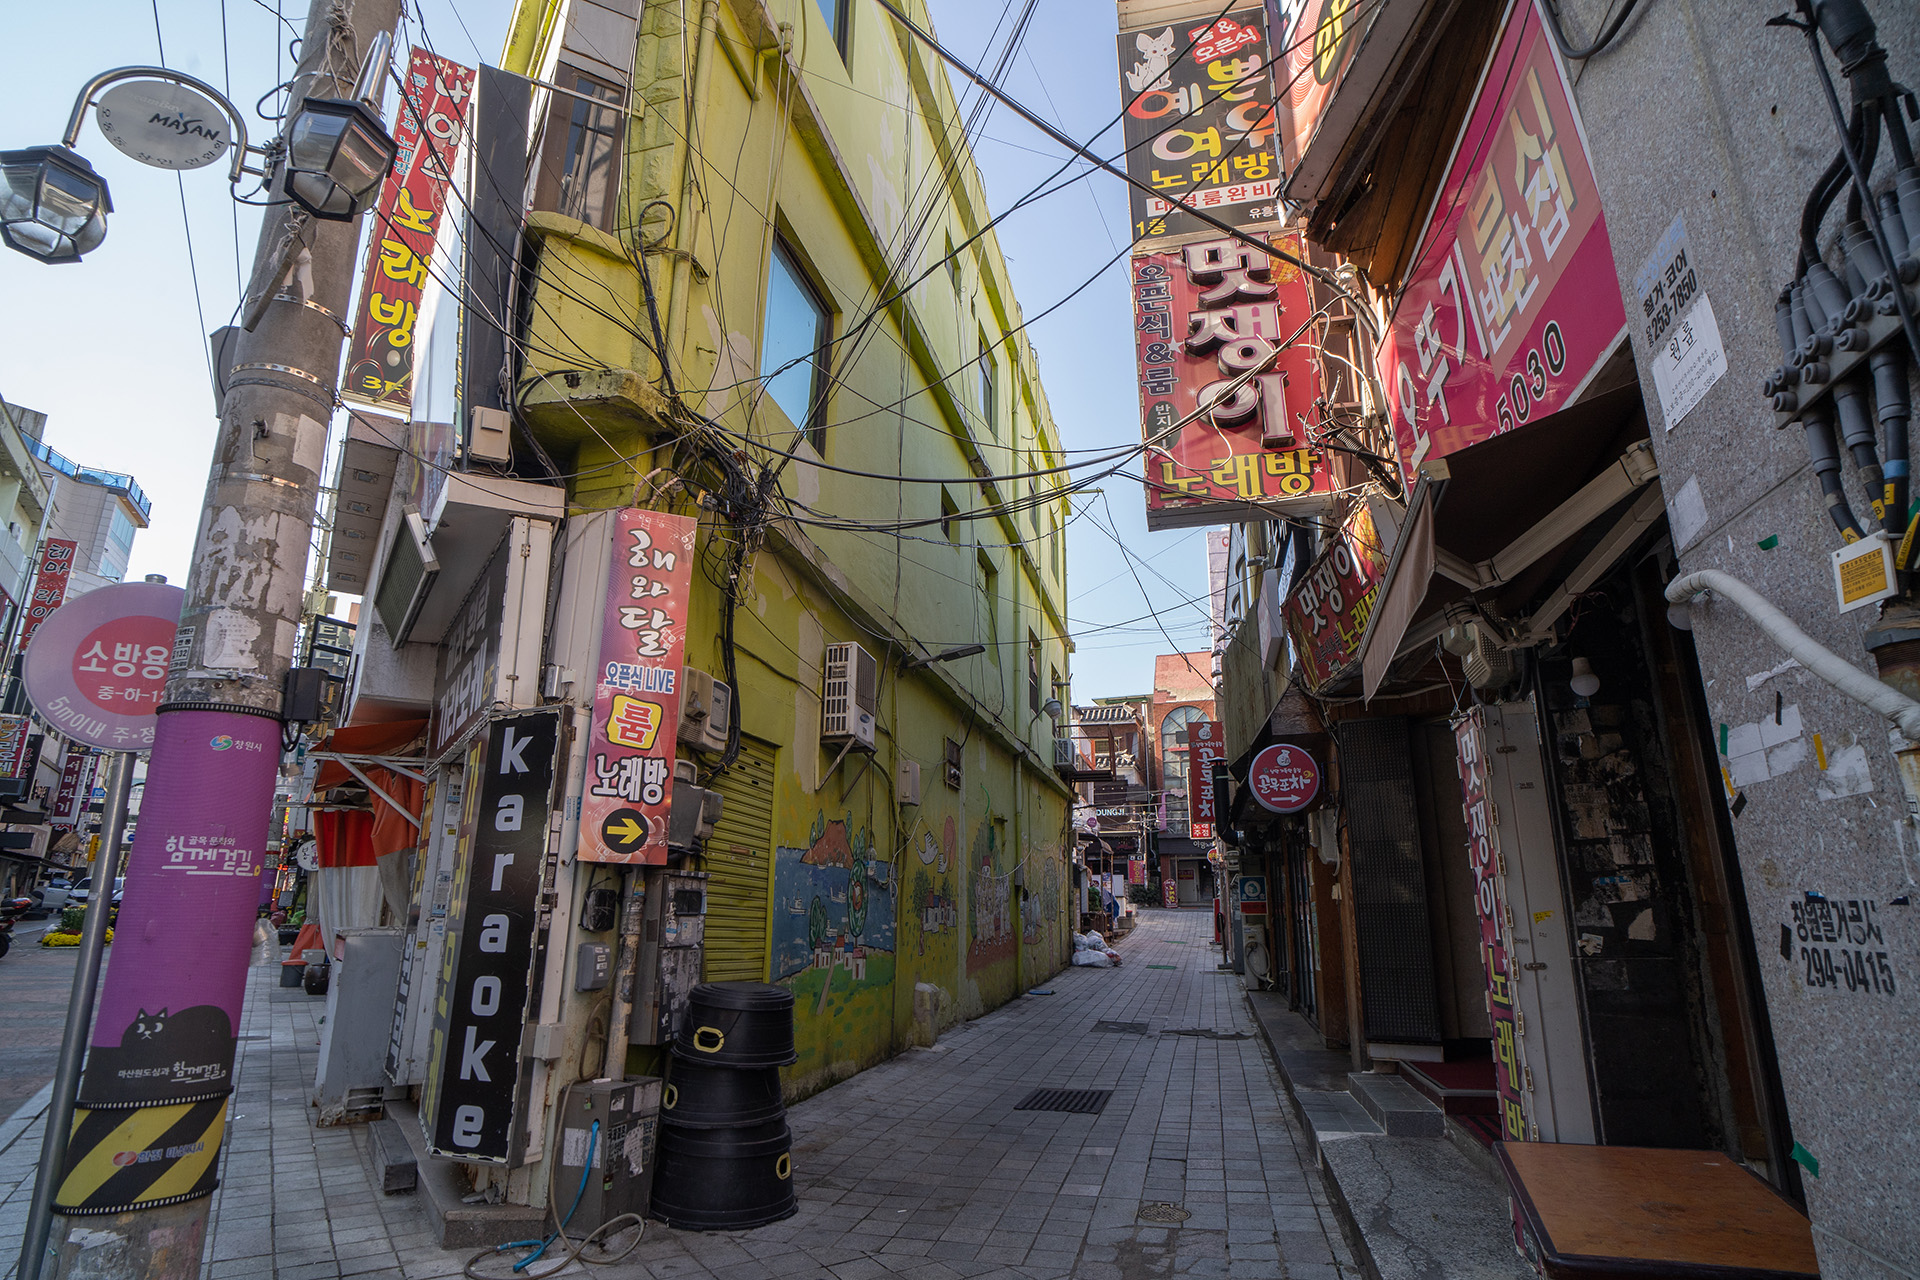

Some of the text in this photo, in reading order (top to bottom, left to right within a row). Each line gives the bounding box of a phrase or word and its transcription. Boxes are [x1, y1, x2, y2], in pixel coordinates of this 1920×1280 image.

[1194, 27, 1259, 63] 오픈식
[1217, 19, 1237, 34] &
[148, 112, 220, 141] MASAN
[1151, 151, 1275, 190] 노래방
[1136, 217, 1167, 237] 1층
[369, 186, 436, 348] 노래방
[1477, 149, 1571, 355] 반찬집
[1651, 267, 1698, 342] 253-7850
[1182, 231, 1289, 442] 멋쟁이
[1397, 236, 1490, 470] 오뚜기
[1669, 320, 1694, 362] 원룸
[1160, 450, 1319, 500] 노래방
[1873, 506, 1882, 516] B
[1846, 533, 1856, 543] A
[618, 528, 677, 658] 해와달
[79, 640, 169, 680] 소방용
[604, 661, 676, 694] 오픈식 LIVE
[437, 636, 488, 751] 가라오케
[481, 662, 496, 703] 2F
[49, 696, 107, 739] 5m이내
[615, 702, 654, 744] 룸
[234, 739, 263, 753] 창원시
[591, 753, 670, 805] 노래방
[1258, 773, 1311, 794] 골목포차
[1460, 727, 1501, 941] 멋쟁이
[452, 726, 535, 1149] karaoke
[1801, 946, 1896, 997] 294-0415
